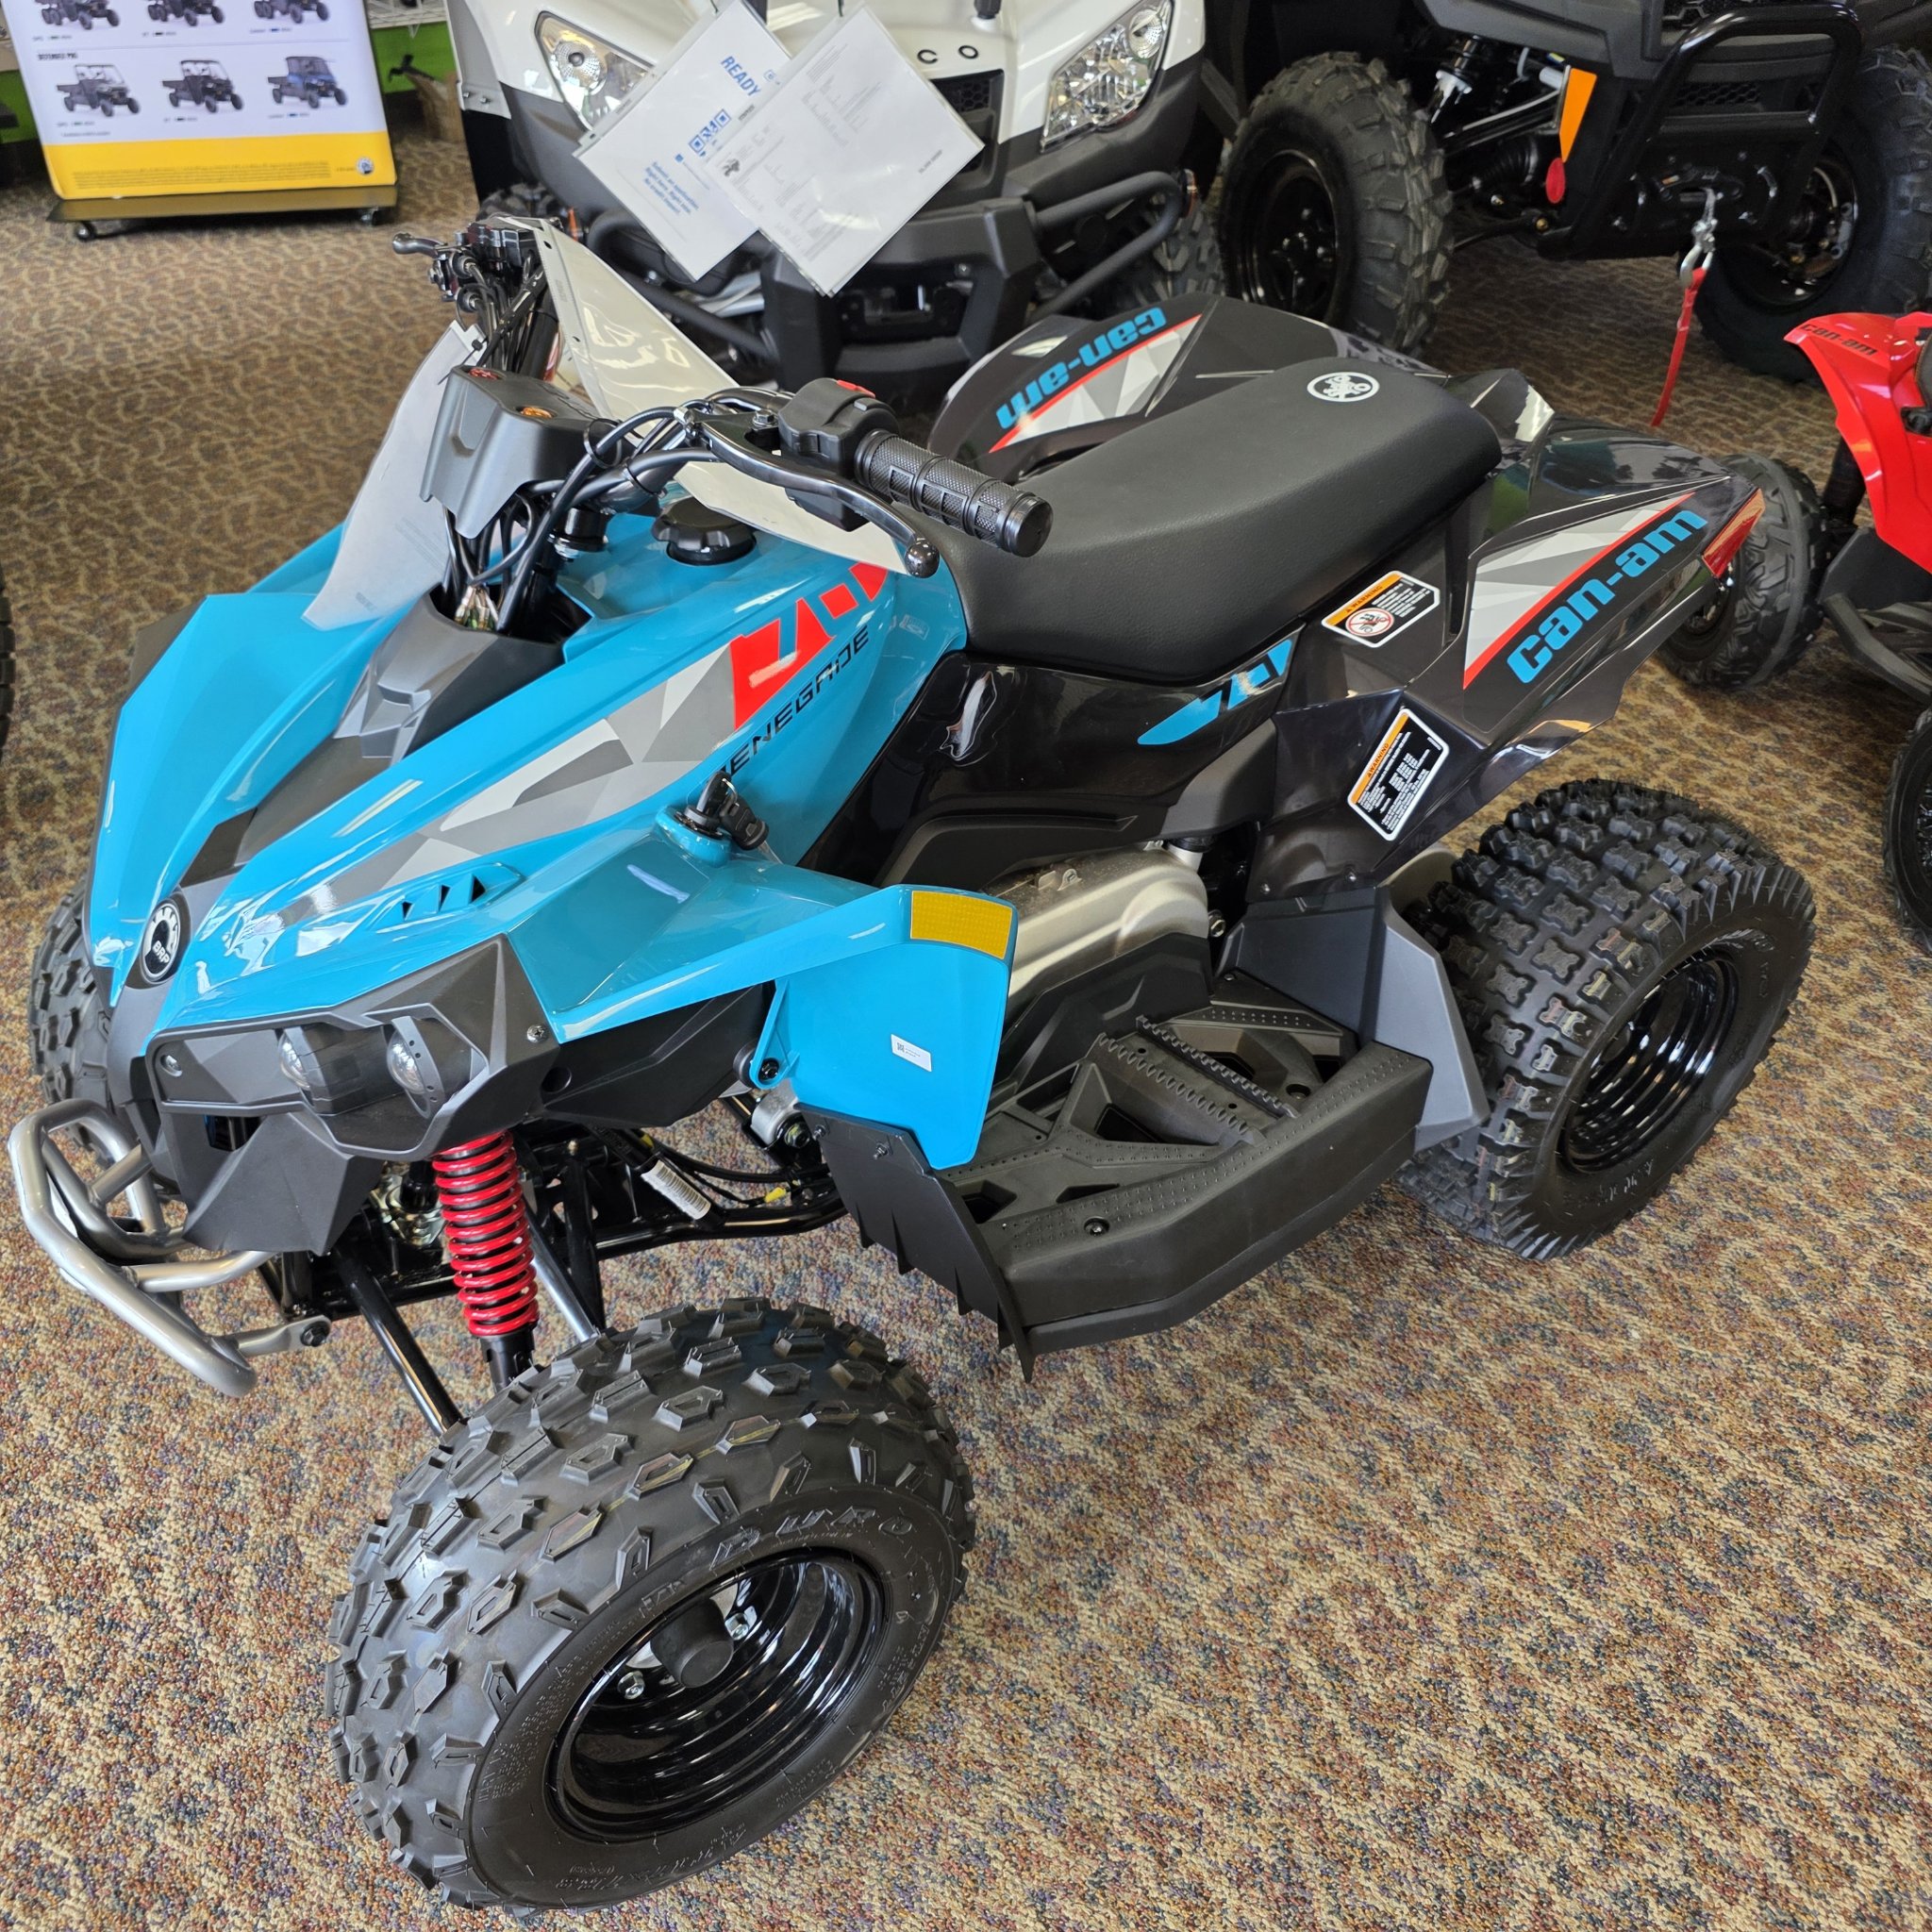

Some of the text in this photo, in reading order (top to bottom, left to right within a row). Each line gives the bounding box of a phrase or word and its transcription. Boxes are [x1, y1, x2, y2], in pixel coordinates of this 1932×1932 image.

[721, 55, 761, 96] READY
[1801, 324, 1878, 356] can-am
[996, 307, 1168, 430] can-am
[1351, 584, 1383, 608] WARNING
[1507, 509, 1707, 684] can-am
[721, 625, 870, 778] ENEGADE
[1368, 741, 1390, 774] WARNING
[152, 940, 171, 964] BRP
